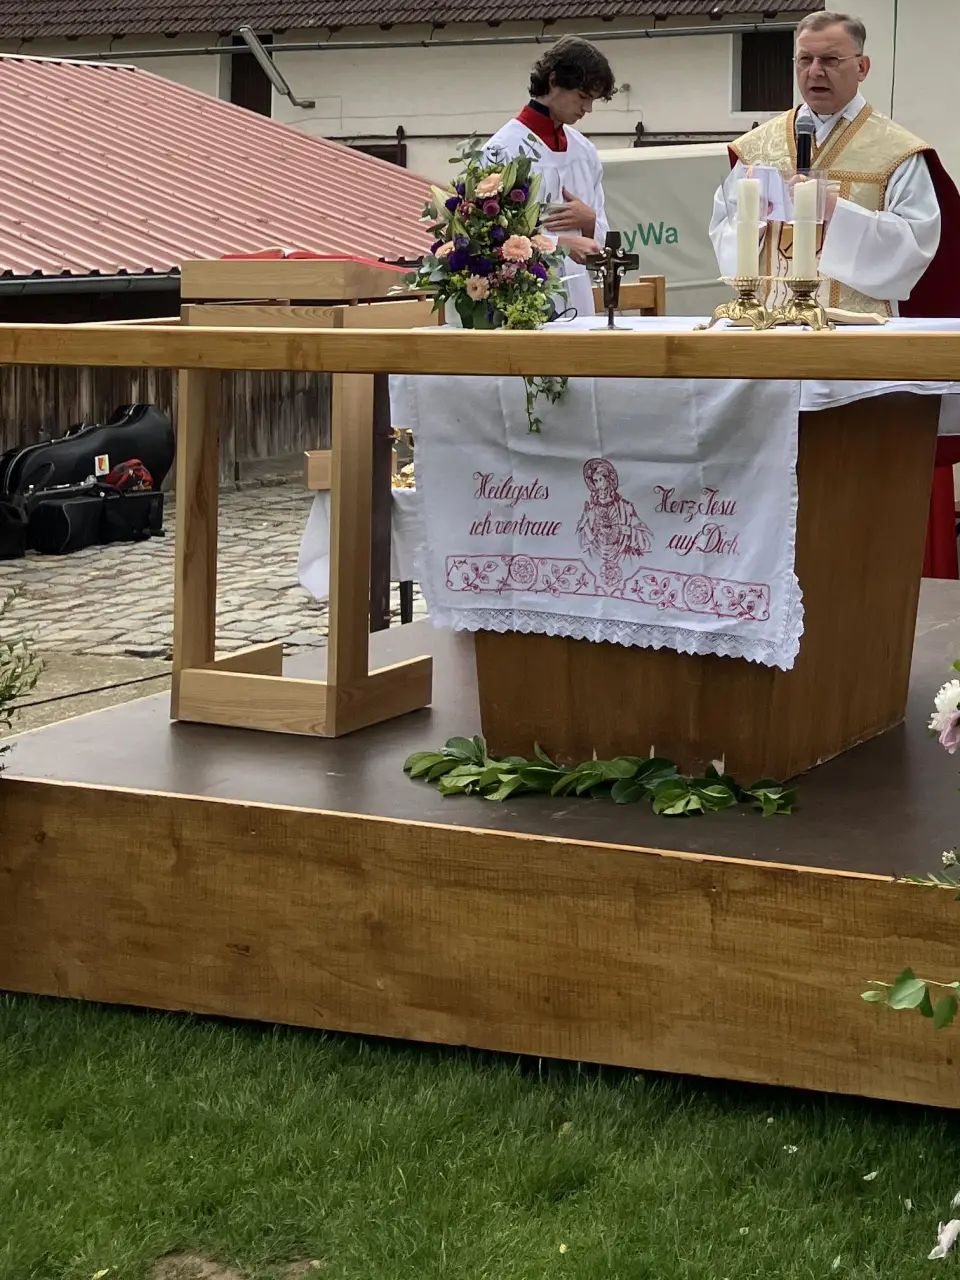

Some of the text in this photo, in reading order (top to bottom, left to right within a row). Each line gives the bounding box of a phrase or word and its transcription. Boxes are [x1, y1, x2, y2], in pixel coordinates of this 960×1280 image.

[622, 221, 679, 253] yWa
[472, 471, 737, 523] Heiligstes Herz Jesu
[469, 510, 492, 536] ich
[495, 513, 563, 536] vertraue
[666, 531, 702, 556] auf
